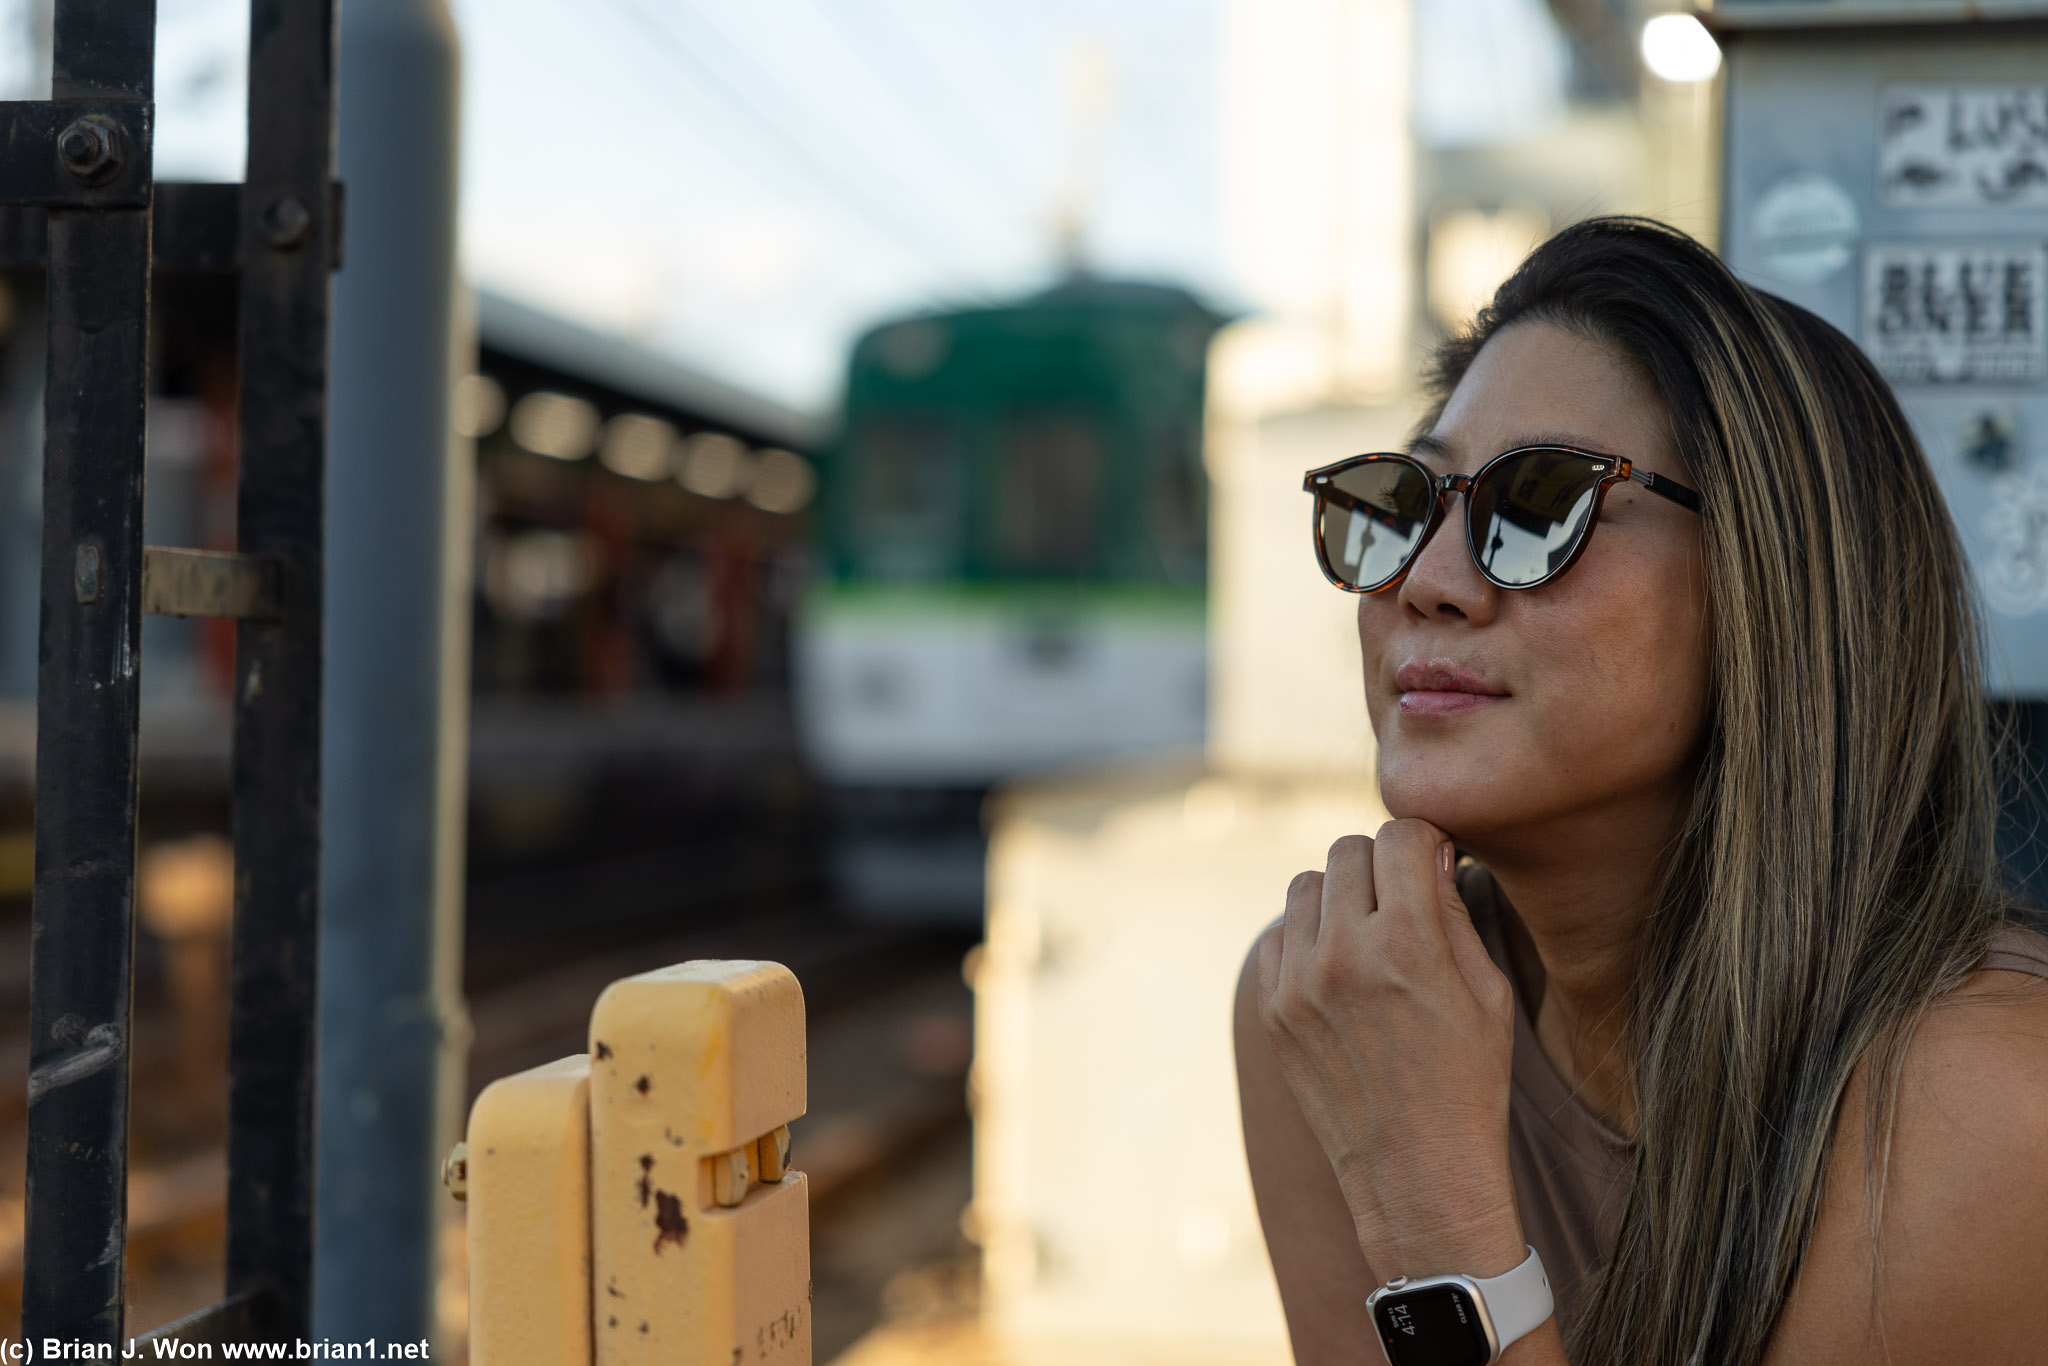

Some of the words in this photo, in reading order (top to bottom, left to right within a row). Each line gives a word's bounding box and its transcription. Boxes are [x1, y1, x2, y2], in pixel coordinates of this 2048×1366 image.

[1880, 260, 2031, 298] BLUE
[1390, 1315, 1399, 1328] SUN
[1394, 1303, 1415, 1335] 4:14
[1455, 1304, 1467, 1324] CLEAR
